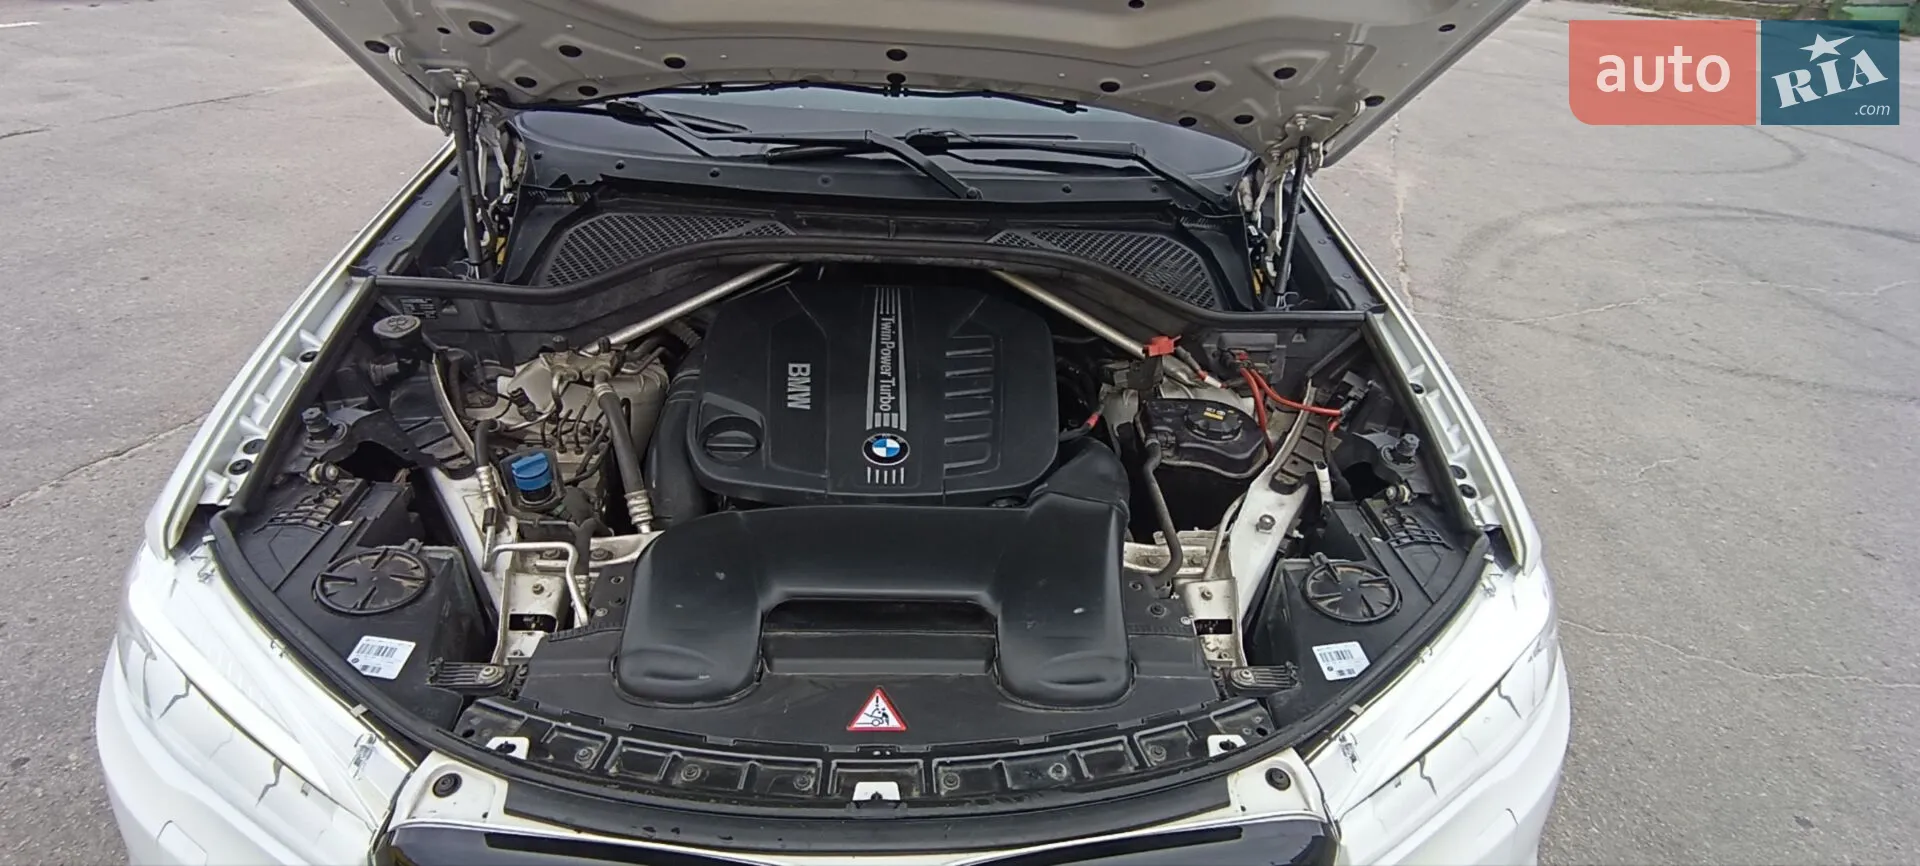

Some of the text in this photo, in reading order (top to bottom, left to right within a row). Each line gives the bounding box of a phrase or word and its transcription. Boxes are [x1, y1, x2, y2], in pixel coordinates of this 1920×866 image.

[787, 363, 811, 410] BMW
[879, 315, 896, 412] TwinPower Turbo
